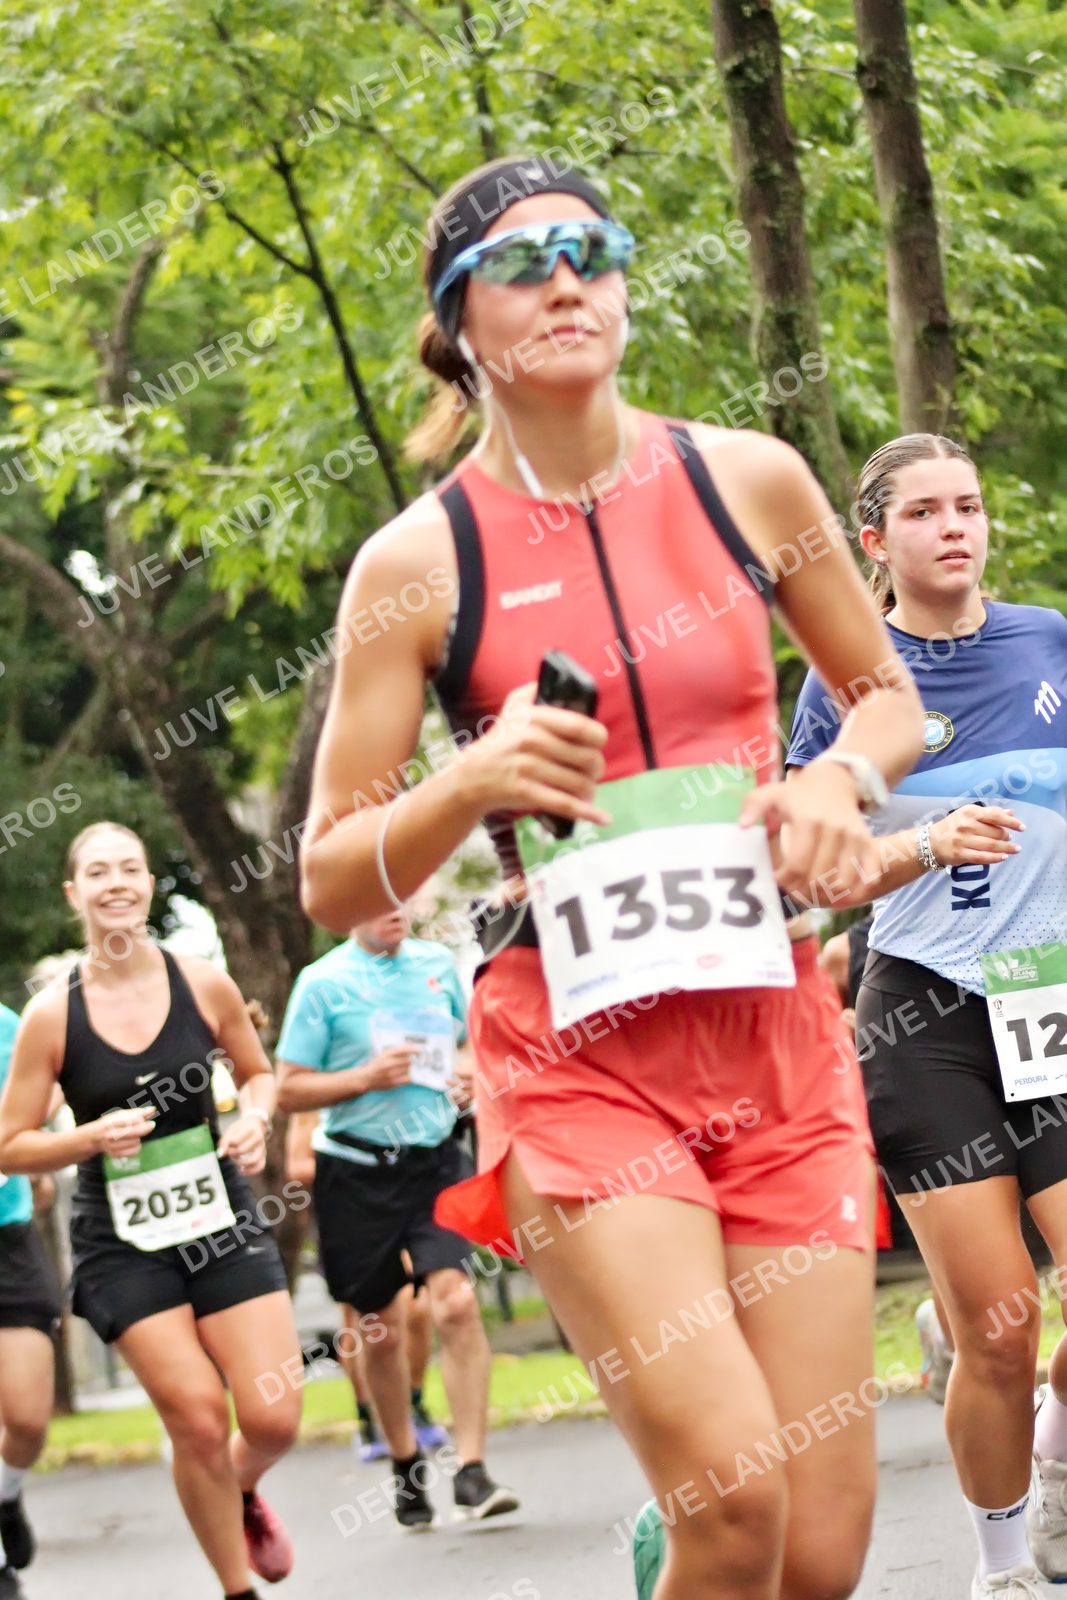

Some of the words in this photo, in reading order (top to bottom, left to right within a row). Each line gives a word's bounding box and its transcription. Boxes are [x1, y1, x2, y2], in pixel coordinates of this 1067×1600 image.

[554, 867, 764, 958] 1353
[1014, 1075, 1048, 1086] PERDURA
[122, 1174, 215, 1227] 2035
